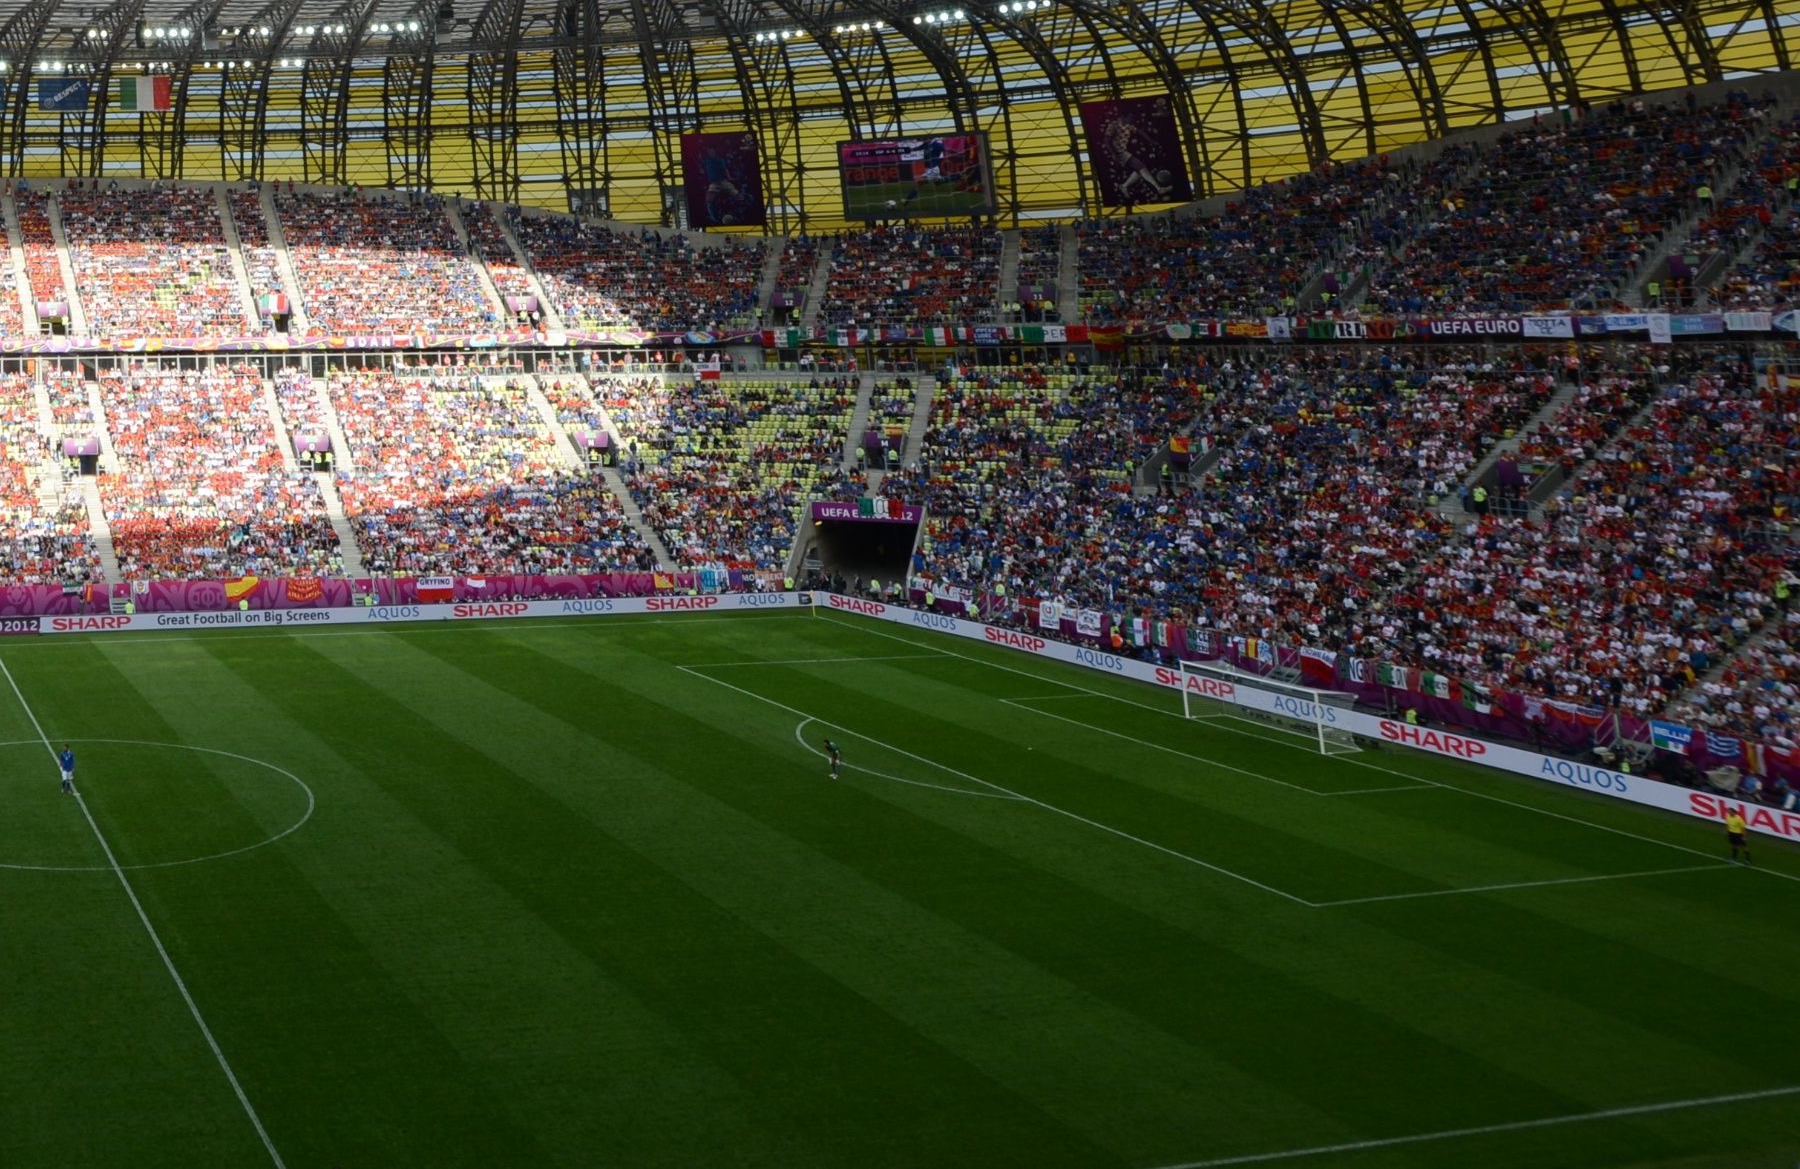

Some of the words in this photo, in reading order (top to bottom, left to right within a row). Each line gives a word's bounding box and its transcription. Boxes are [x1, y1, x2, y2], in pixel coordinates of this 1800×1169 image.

[53, 81, 82, 102] RESPECT
[1431, 321, 1472, 335] UEFA
[1478, 320, 1520, 334] EURO
[821, 508, 850, 519] UEFA
[419, 577, 450, 586] GRYFINO
[562, 599, 613, 613] AQUOS
[646, 596, 718, 611] SHARP
[738, 593, 785, 607] AQUOS
[829, 594, 886, 616] SHARP
[368, 605, 420, 619] AQUOS
[454, 602, 528, 617] SHARP
[52, 616, 131, 630] SHARP
[157, 614, 190, 626] Great
[194, 611, 241, 624] Football
[246, 614, 262, 623] on
[265, 611, 283, 624] Big
[287, 609, 330, 621] Screens
[913, 611, 956, 630] AQUOS
[4, 620, 38, 633] 2012
[985, 626, 1045, 651] SHARP
[1075, 648, 1123, 671] AQUOS
[1155, 667, 1234, 698] SHARP
[1379, 720, 1486, 758] SHARP
[1541, 757, 1628, 793] AQUOS
